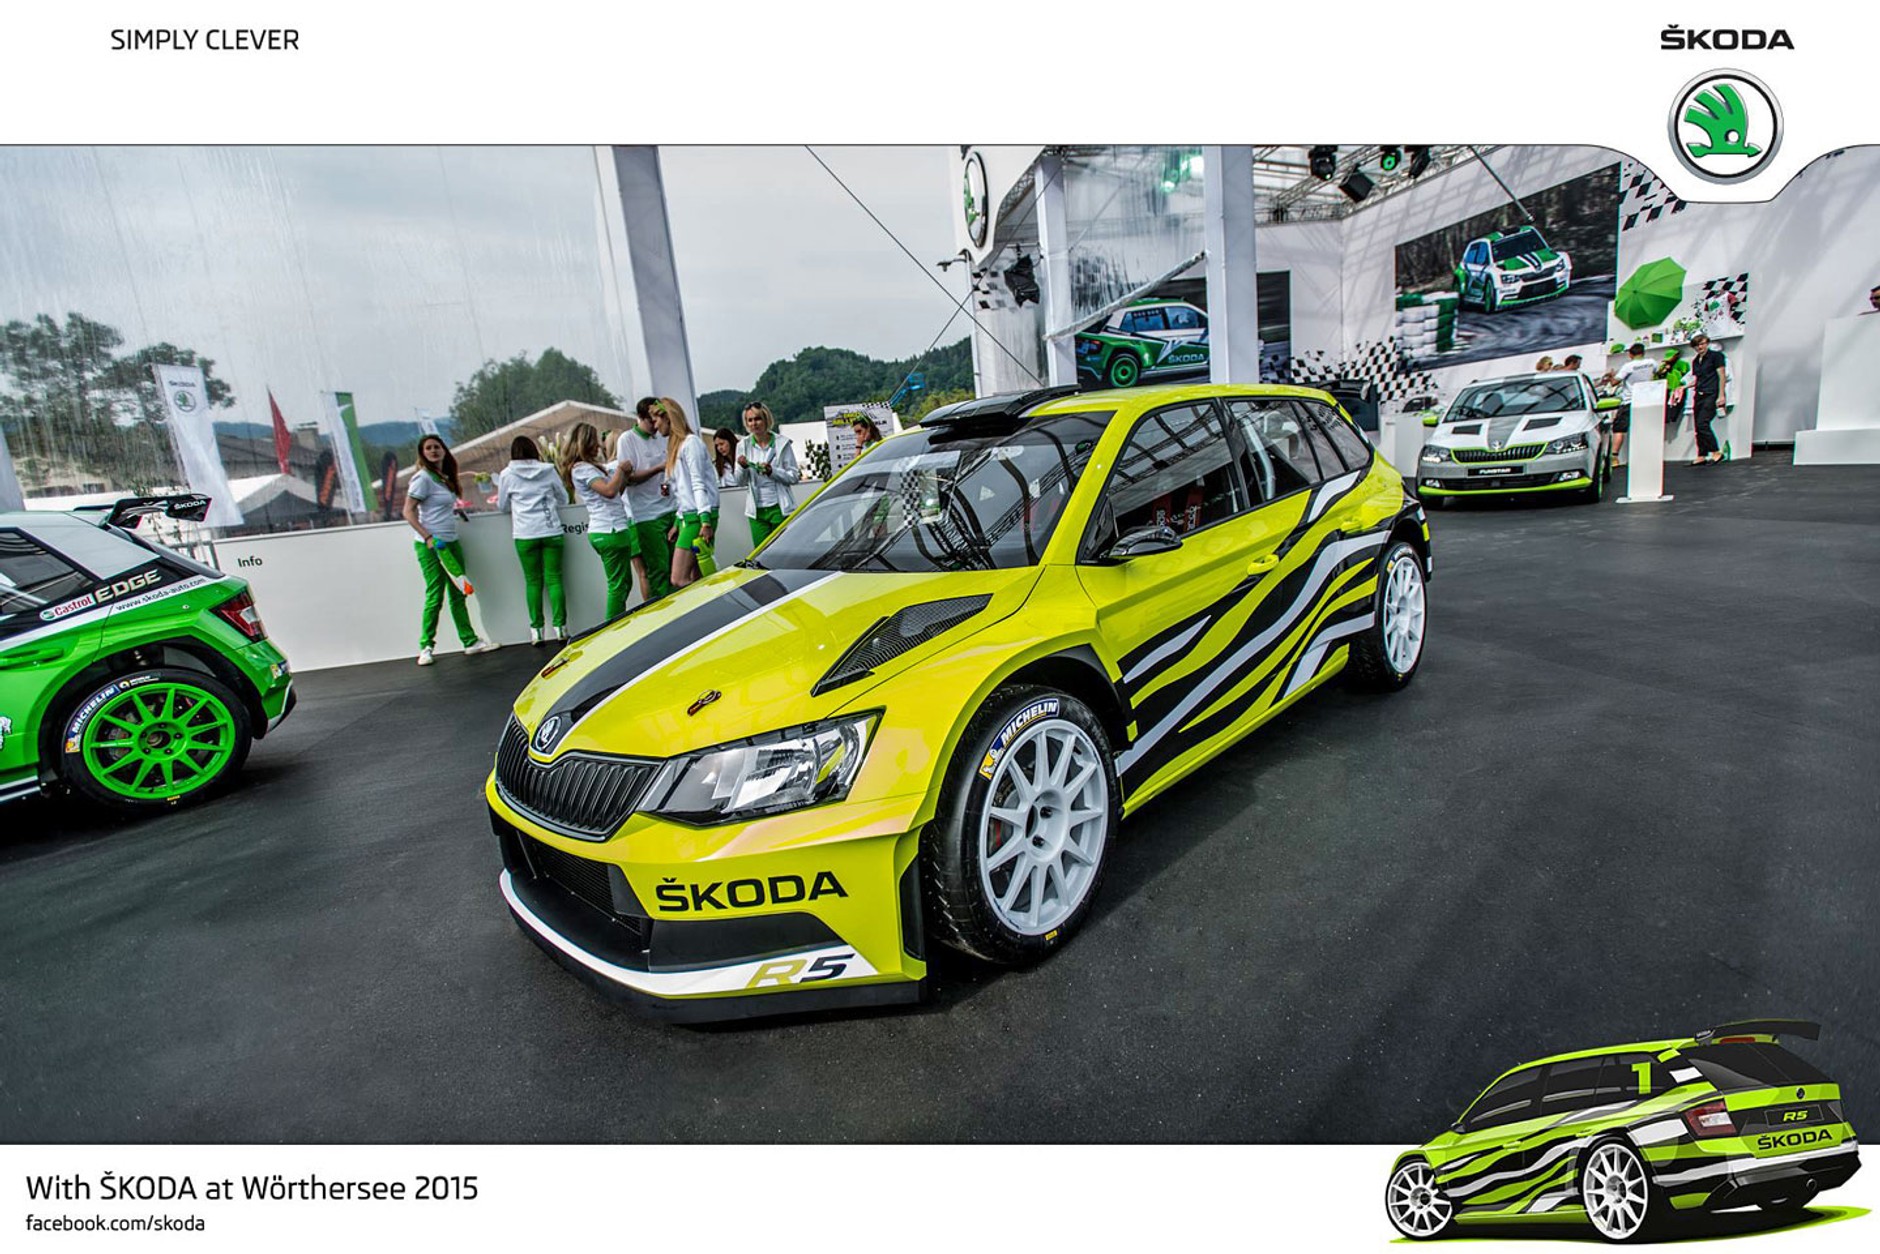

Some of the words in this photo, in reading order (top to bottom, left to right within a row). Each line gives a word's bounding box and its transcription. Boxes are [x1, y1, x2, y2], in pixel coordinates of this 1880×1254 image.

[237, 555, 263, 568] Info
[54, 595, 93, 617] Castrol
[95, 568, 162, 604] EDGE
[116, 577, 207, 612] www.skoda-auto.com
[71, 686, 116, 734] MICHELIN
[1000, 702, 1057, 746] MICHELIN
[655, 871, 849, 912] ŠKODA
[744, 953, 856, 989] R5
